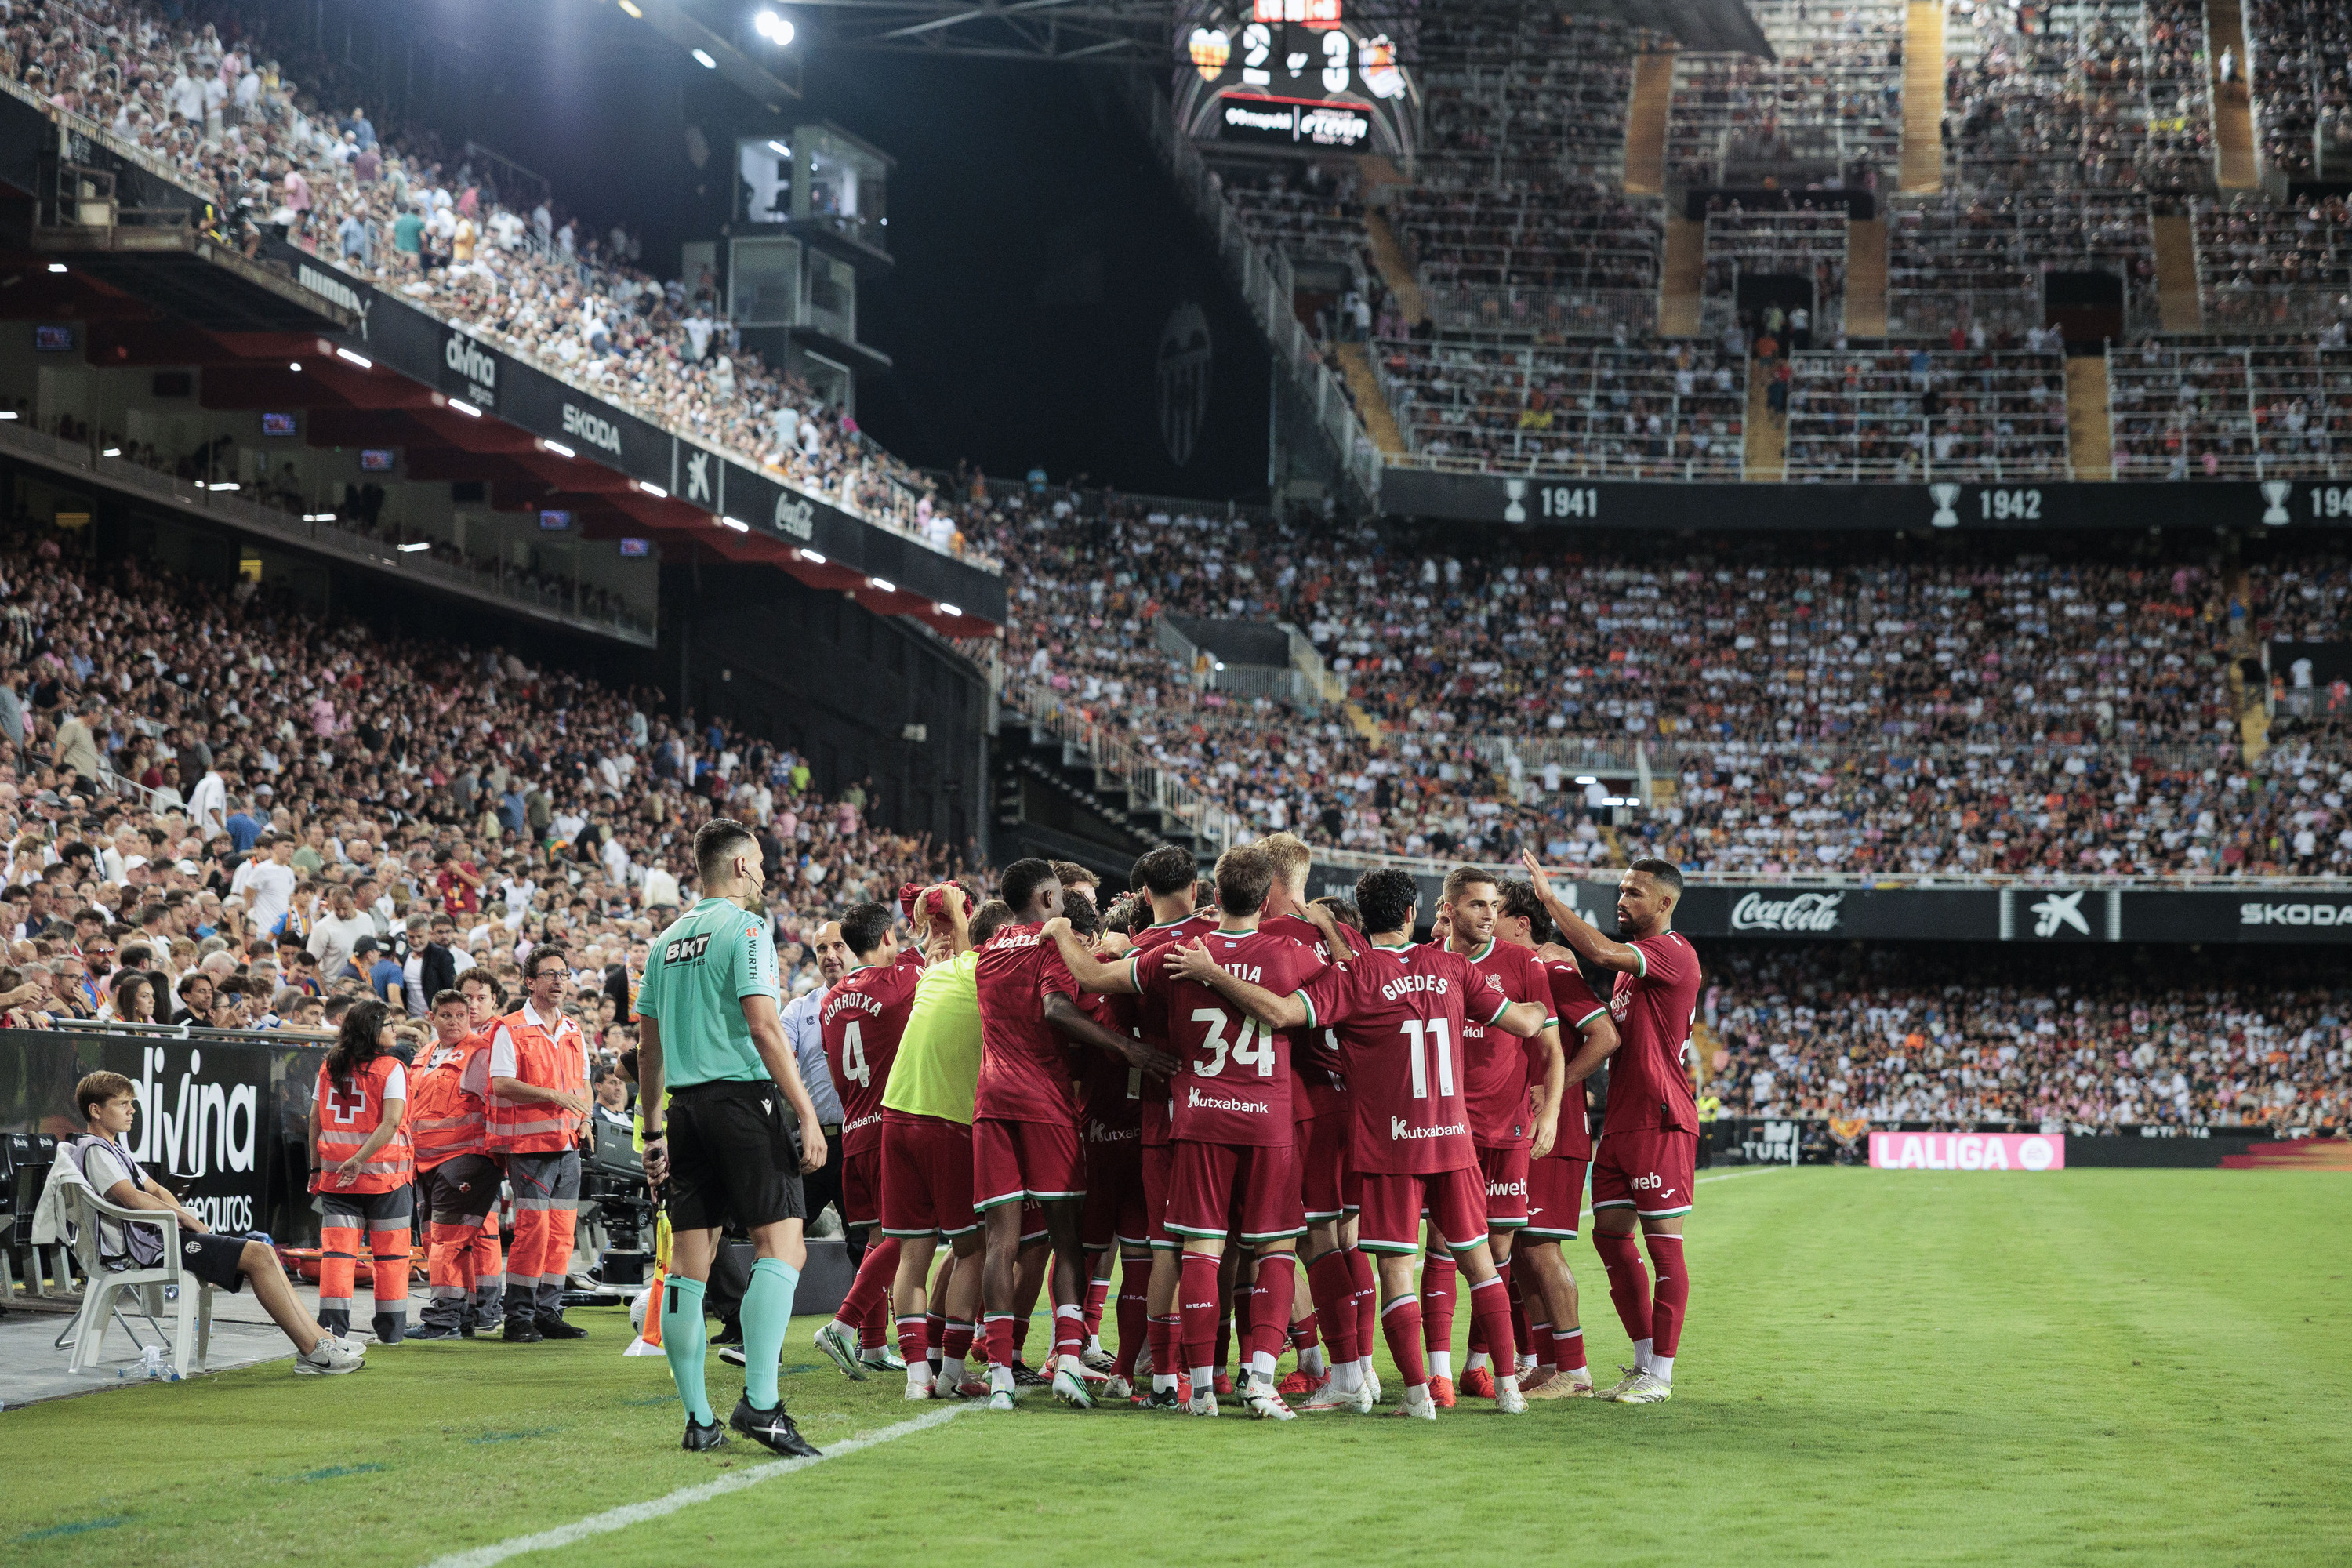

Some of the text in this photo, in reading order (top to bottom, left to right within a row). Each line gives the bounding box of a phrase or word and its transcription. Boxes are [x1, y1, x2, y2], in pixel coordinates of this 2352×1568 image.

[1243, 23, 1271, 86] 2
[1540, 486, 1598, 517] 1941
[1979, 488, 2042, 520] 1942
[2309, 485, 2352, 518] 194
[665, 935, 710, 961] BKT
[748, 939, 757, 980] WÜRTH
[1381, 975, 1448, 1001] GUEDES
[824, 992, 883, 1025] GORROTXA
[842, 1020, 870, 1087] 4
[1191, 1007, 1276, 1077] 34
[1399, 1018, 1454, 1098] 11
[118, 1046, 257, 1174] divina
[1187, 1085, 1269, 1115] Kutxabank
[1089, 1119, 1141, 1142] Kutxab
[1391, 1116, 1466, 1141] Kutxabank
[1742, 1141, 1790, 1161] TUR
[1878, 1135, 2009, 1171] LALIGA
[1630, 1171, 1661, 1190] web
